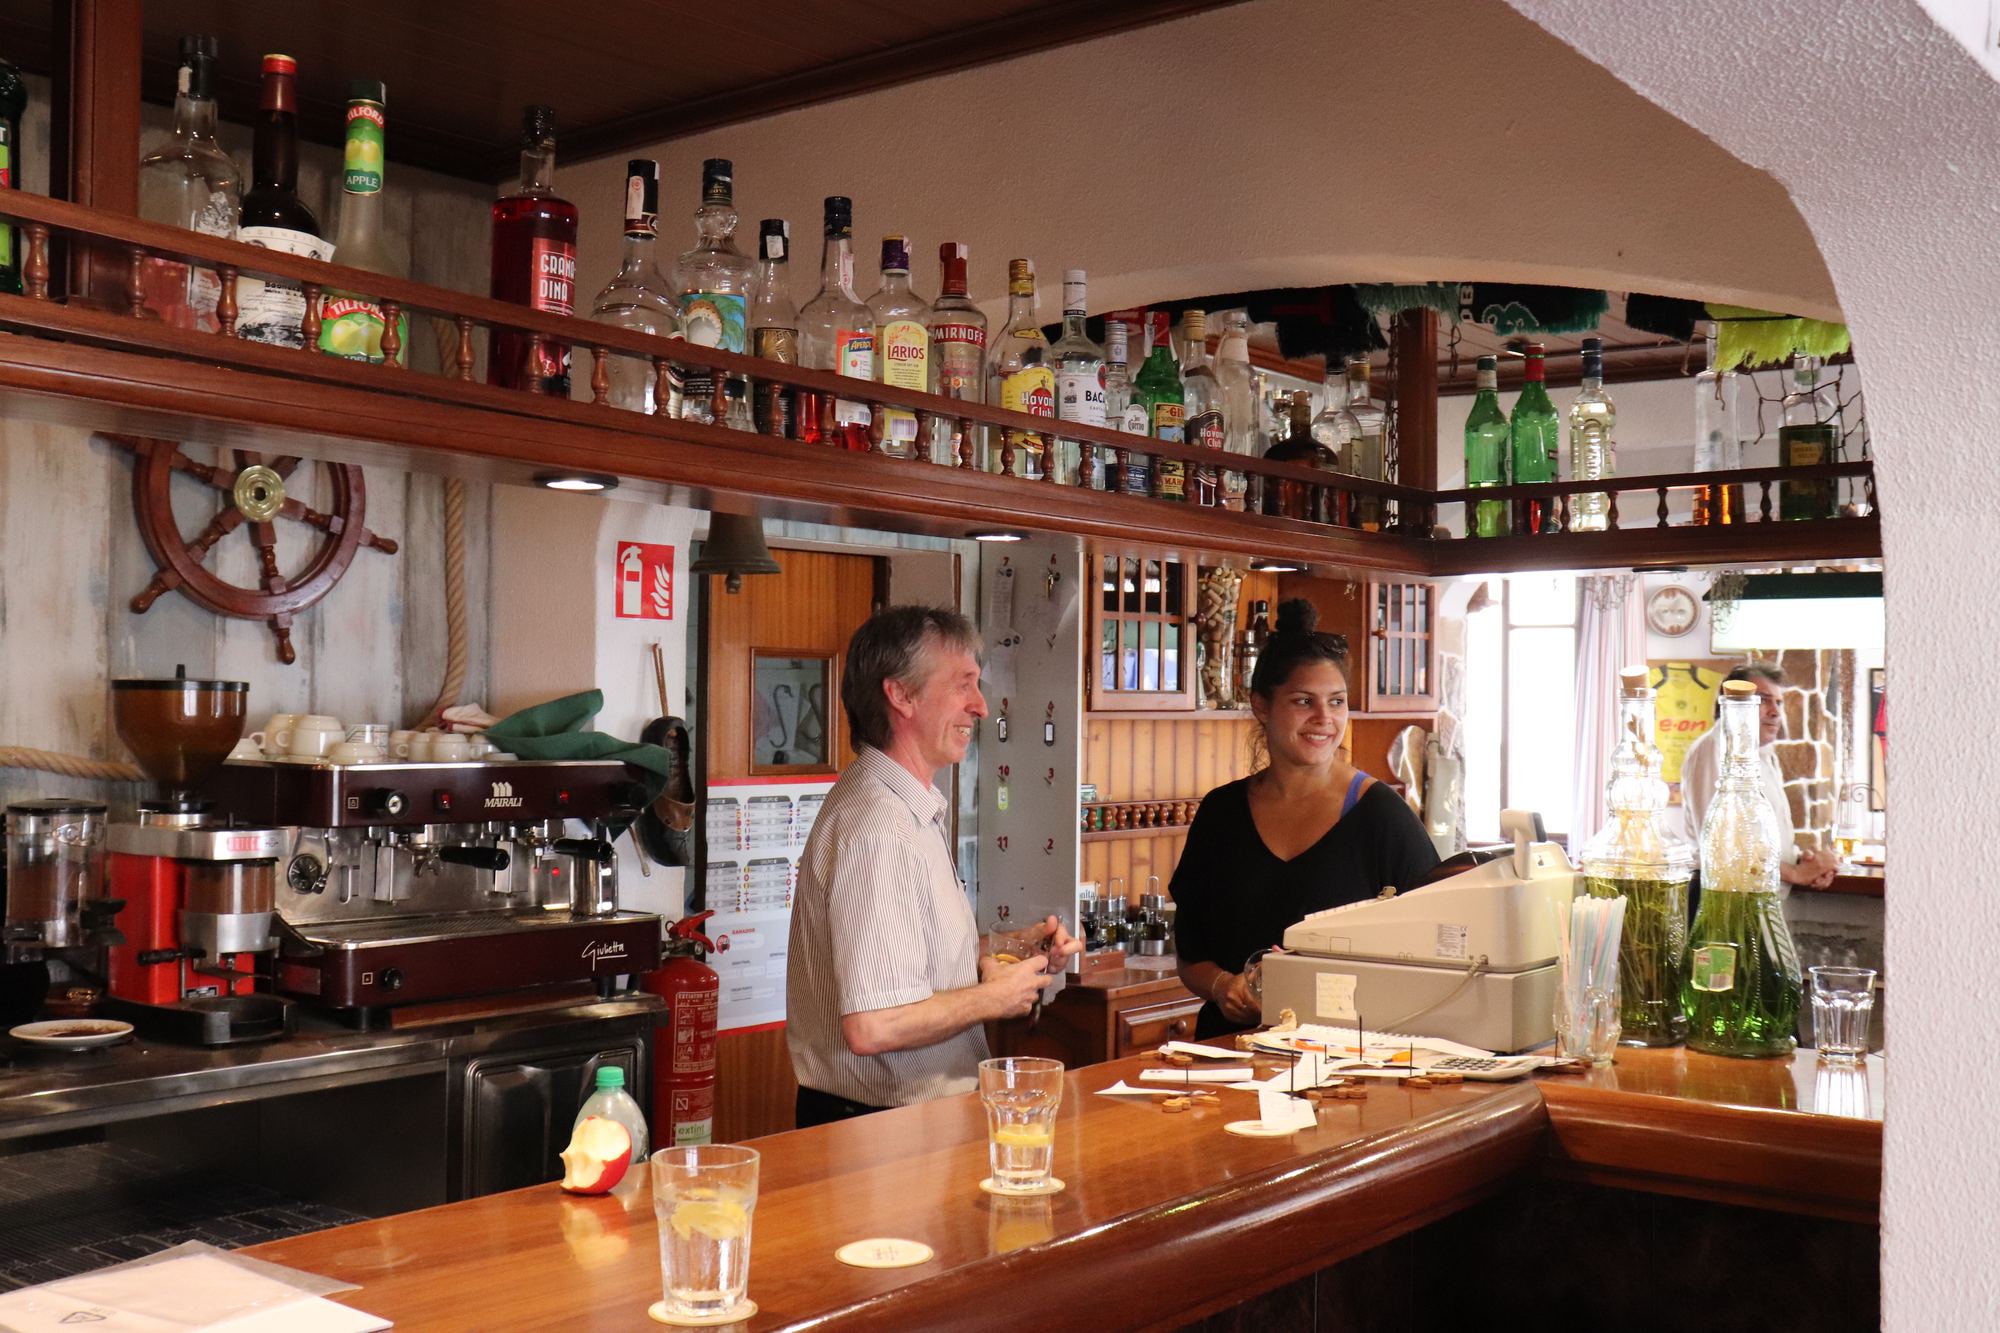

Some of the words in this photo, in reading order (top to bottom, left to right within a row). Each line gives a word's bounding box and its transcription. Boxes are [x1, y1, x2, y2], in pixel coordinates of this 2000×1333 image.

[345, 175, 379, 189] APPLE
[539, 279, 568, 302] DINA
[330, 298, 387, 321] TILFOR
[929, 326, 984, 344] MIRNOFF
[887, 345, 925, 362] LARIOS
[1002, 556, 1010, 567] 7
[1050, 553, 1057, 565] 6
[1001, 697, 1009, 710] 9
[998, 765, 1010, 777] 10
[1047, 767, 1055, 779] 3
[484, 797, 523, 808] MAIRALI
[996, 836, 1009, 849] 11
[1046, 838, 1054, 850] 2
[997, 905, 1010, 918] 12
[581, 940, 629, 971] Giulietta
